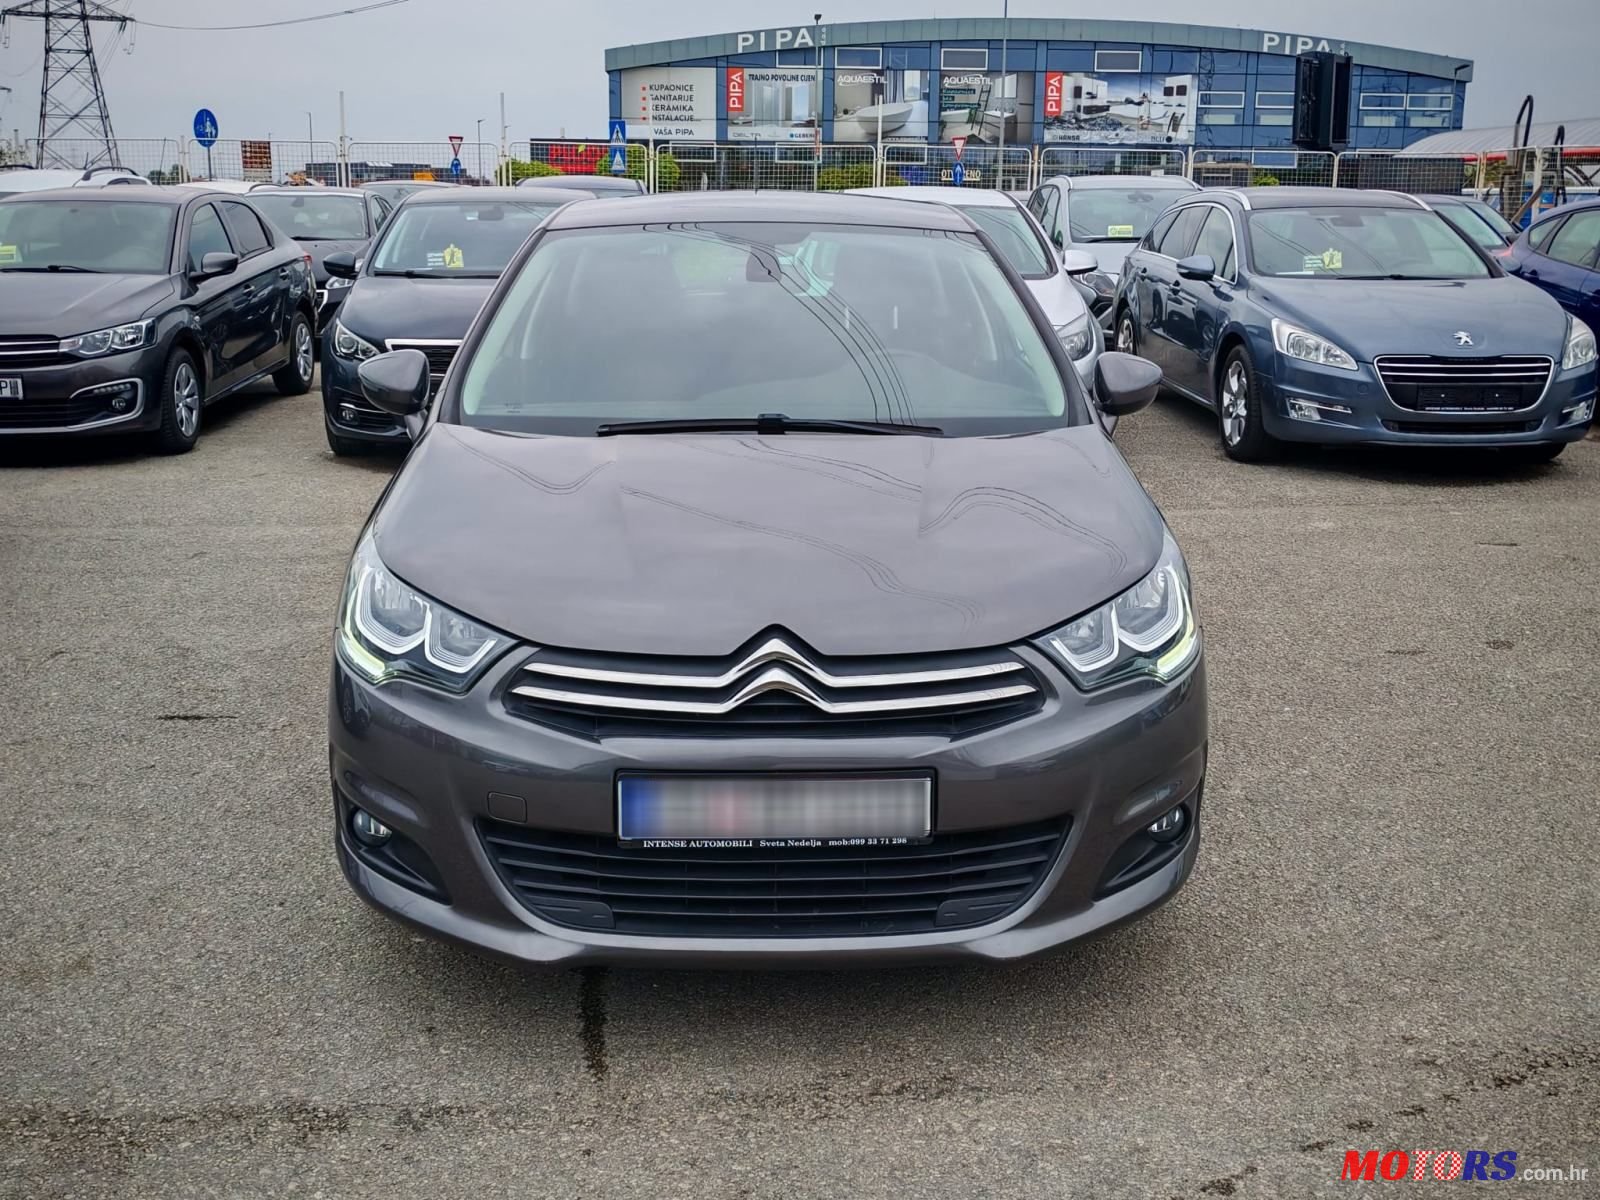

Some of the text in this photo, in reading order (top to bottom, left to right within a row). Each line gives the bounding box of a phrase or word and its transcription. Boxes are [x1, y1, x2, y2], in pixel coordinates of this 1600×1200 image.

[737, 28, 814, 53] PIPA
[1262, 33, 1330, 54] PIPA
[748, 74, 817, 82] TRAJNO POVOLJNE CIJEN
[837, 73, 888, 87] AQUAESTIL
[943, 74, 993, 88] AQUAESTIL
[649, 84, 694, 92] KUPAONICE
[729, 72, 742, 108] PIPA
[1047, 75, 1061, 112] PIPA
[653, 126, 694, 136] VAŠA PIPA
[643, 840, 687, 848] INTENSE
[689, 840, 753, 848] AUTOMOBILI
[759, 839, 785, 847] Sveta
[787, 839, 822, 848] Nedelja
[867, 838, 878, 846] 33
[880, 837, 890, 845] 71
